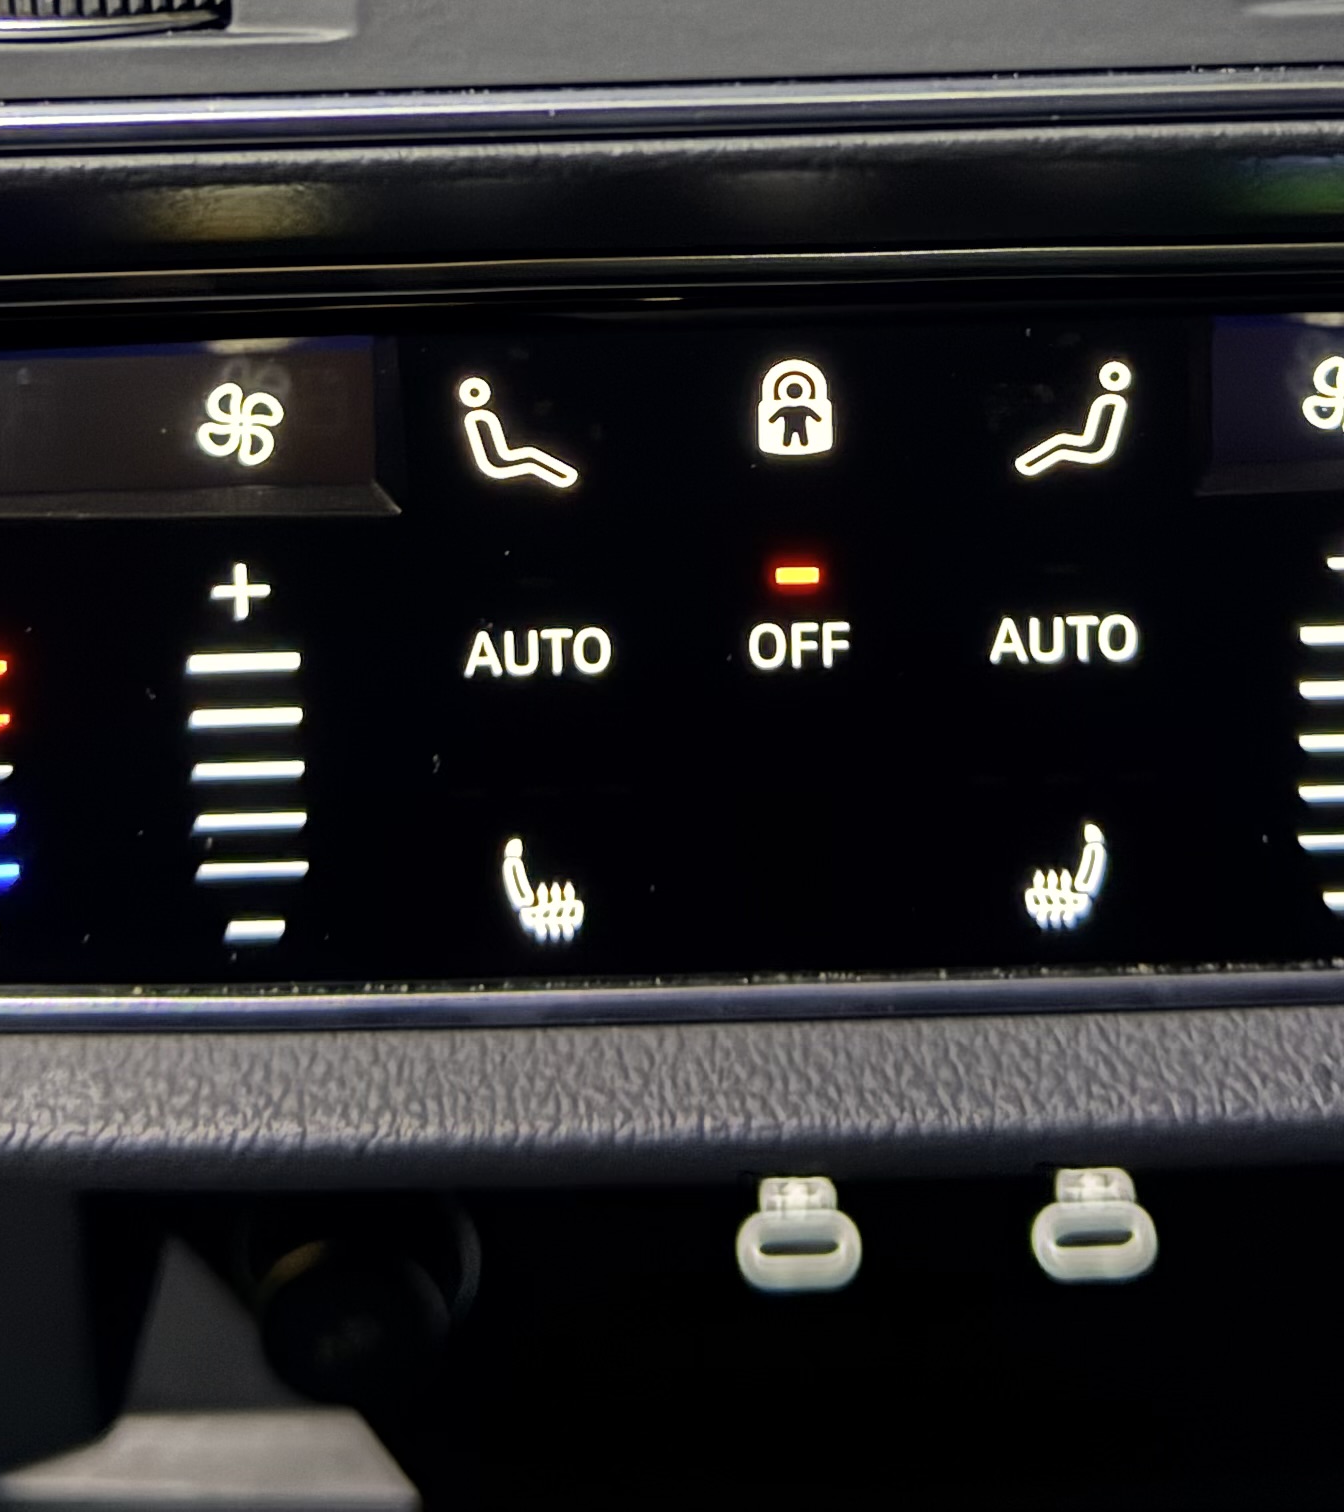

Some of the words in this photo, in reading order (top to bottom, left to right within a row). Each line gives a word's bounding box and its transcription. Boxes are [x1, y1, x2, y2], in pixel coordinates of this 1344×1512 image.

[462, 626, 612, 679] AUTO
[747, 619, 851, 671] OFF
[988, 612, 1139, 665] AUTO
